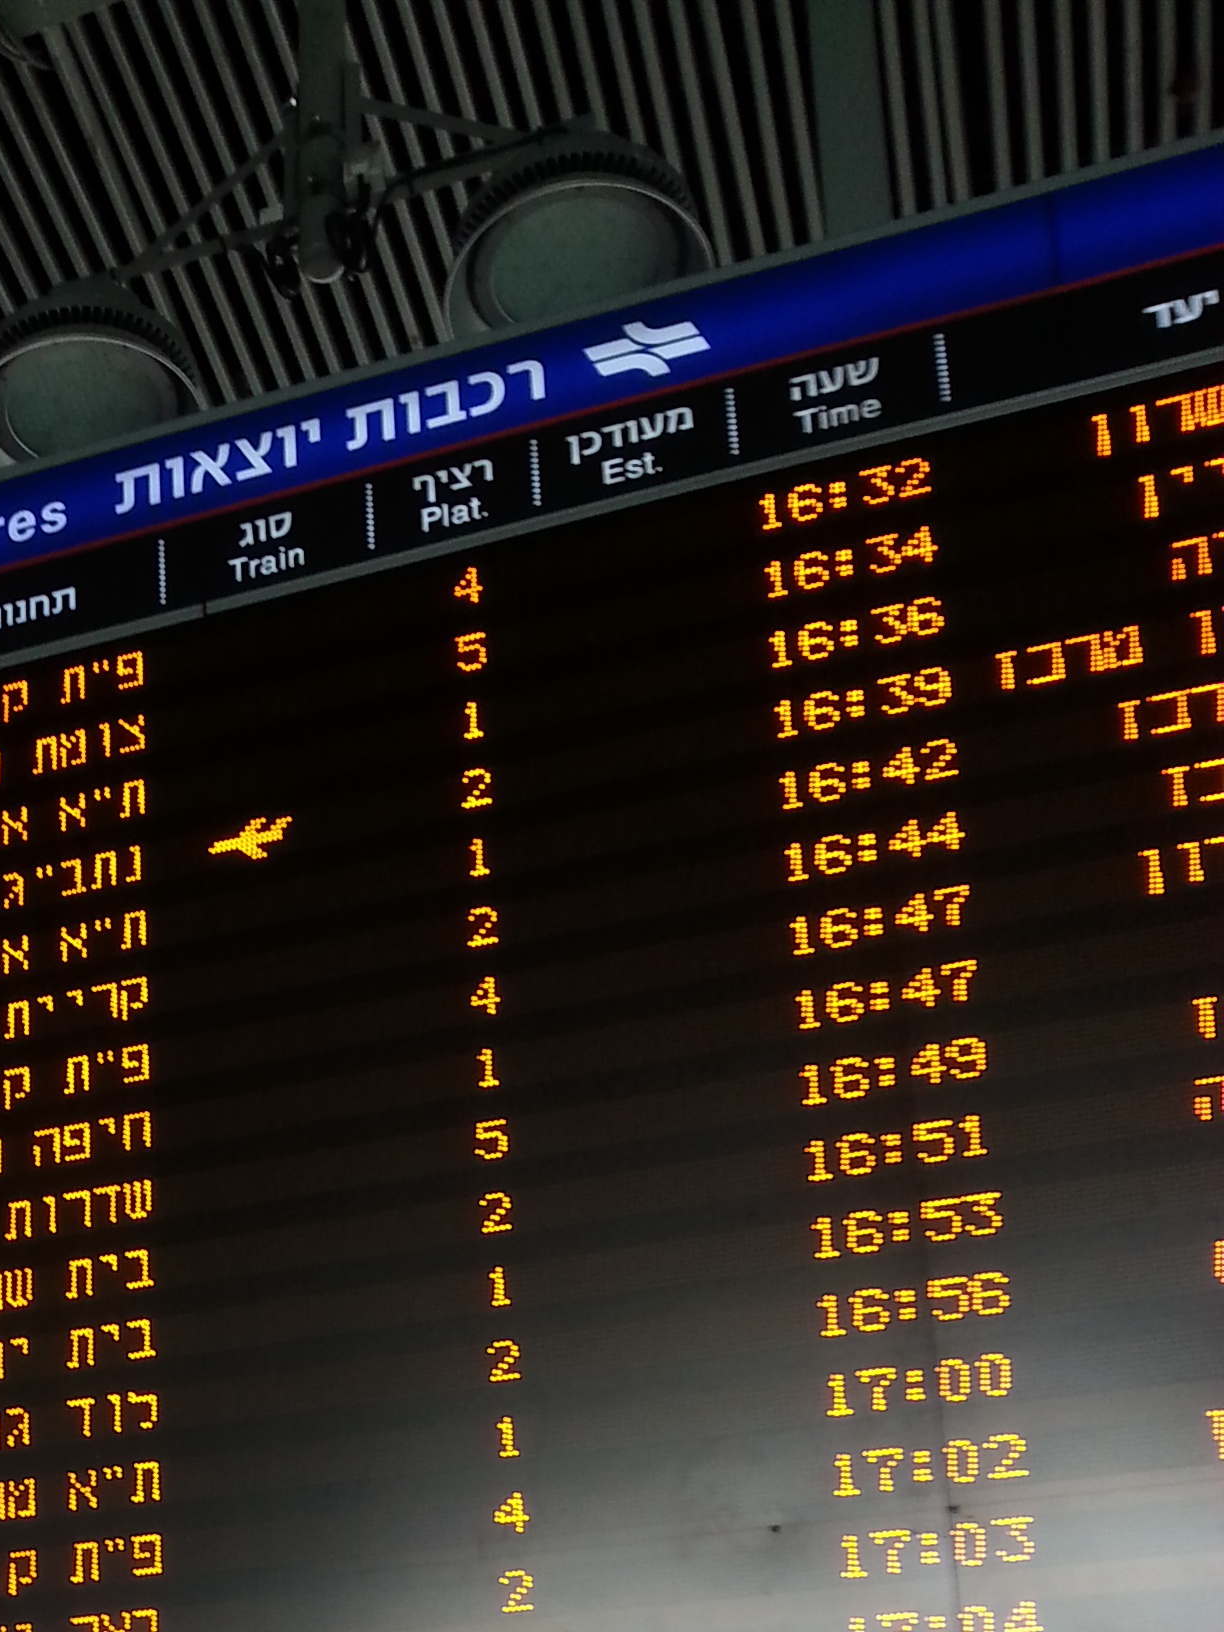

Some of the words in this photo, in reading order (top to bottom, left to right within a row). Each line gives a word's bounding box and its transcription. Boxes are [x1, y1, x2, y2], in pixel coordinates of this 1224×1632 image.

[1140, 288, 1221, 329] יעד
[345, 359, 547, 452] רכבות
[788, 356, 880, 401] שעה
[564, 406, 695, 466] מעודכן
[791, 398, 884, 434] Time
[113, 416, 322, 516] יוצאות
[411, 458, 495, 503] רציף
[600, 452, 664, 486] Est.
[757, 456, 933, 532] 16:32
[238, 511, 294, 548] סוג
[419, 497, 490, 533] Plat.
[227, 546, 306, 583] Train
[452, 565, 485, 605] 4
[762, 524, 940, 600] 16:34
[766, 595, 947, 670] 16:36
[994, 624, 1145, 692] מרכז
[772, 665, 954, 740] 16:39
[31, 712, 147, 776] צומת
[777, 737, 961, 811] 16:42
[782, 810, 967, 883] 16:44
[787, 883, 972, 957] 16:47
[2, 974, 150, 1041] קריית
[793, 958, 979, 1031] 16:47
[797, 1036, 988, 1107] 16:49
[31, 1109, 153, 1168] חיפה
[473, 1117, 510, 1161] 5
[802, 1113, 989, 1183] 16:51
[3, 1177, 154, 1242] שדרות
[809, 1190, 1004, 1260] 16:53
[64, 1247, 156, 1301] בית
[815, 1270, 1012, 1339] 16:56
[65, 1317, 158, 1370] בית
[65, 1390, 159, 1439] לוד
[825, 1352, 1013, 1418] 17:00
[832, 1433, 1030, 1499] 17:02
[840, 1516, 1035, 1580] 17:03
